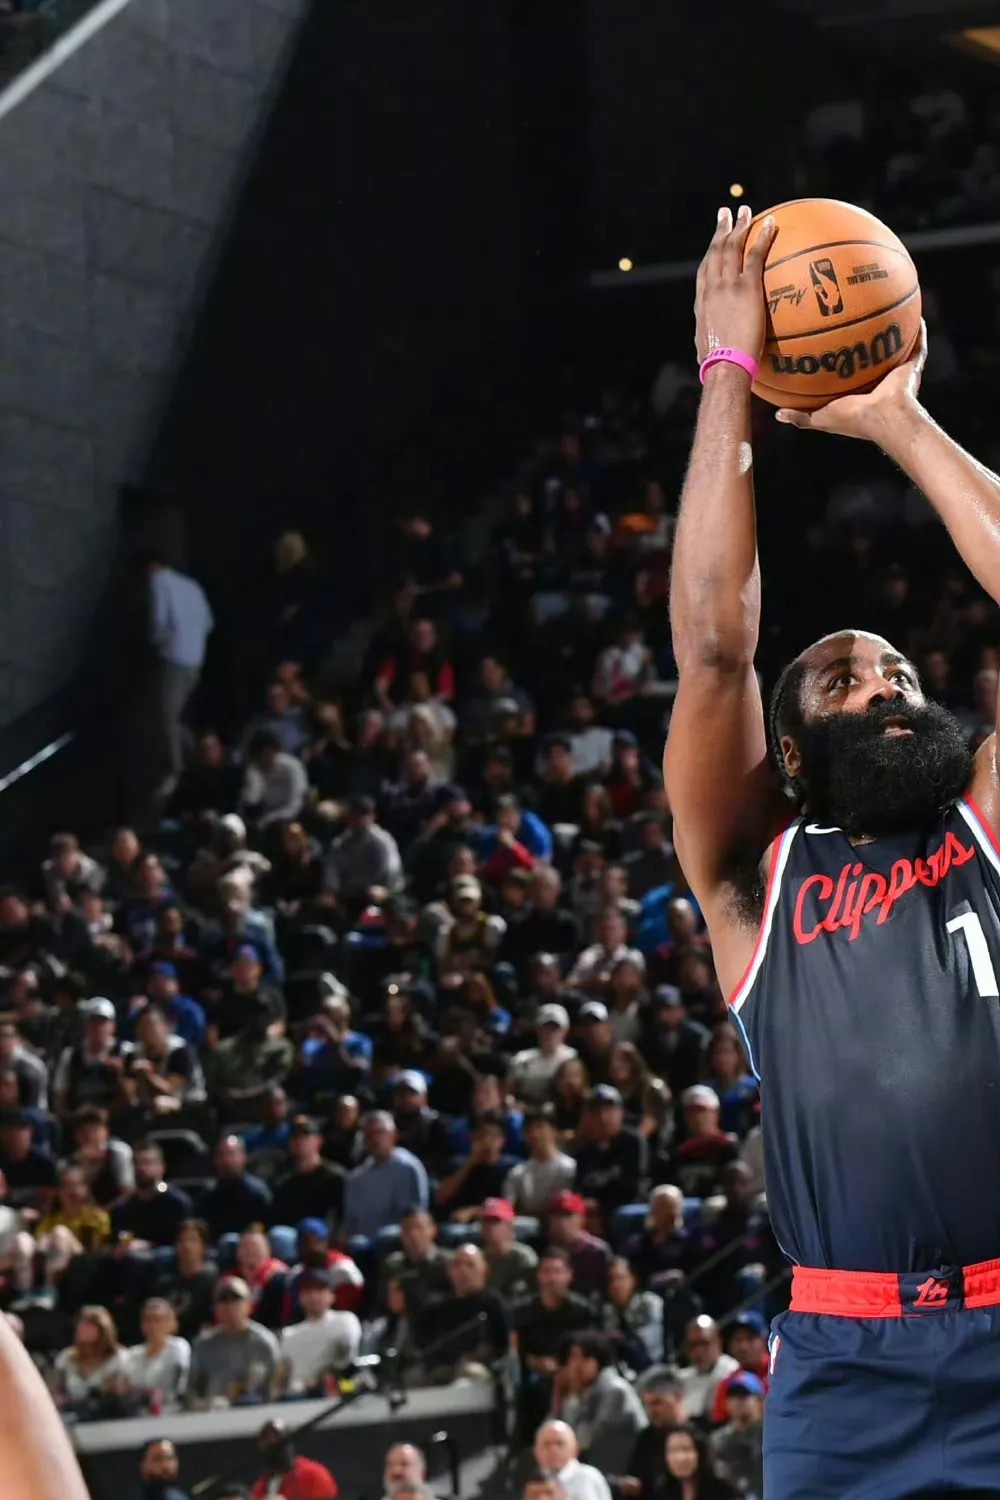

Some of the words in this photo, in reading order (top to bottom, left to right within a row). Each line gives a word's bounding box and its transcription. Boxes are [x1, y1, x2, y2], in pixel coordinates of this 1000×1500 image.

[771, 322, 903, 379] Wilson
[793, 831, 975, 945] Clippers
[946, 911, 1000, 998] 1
